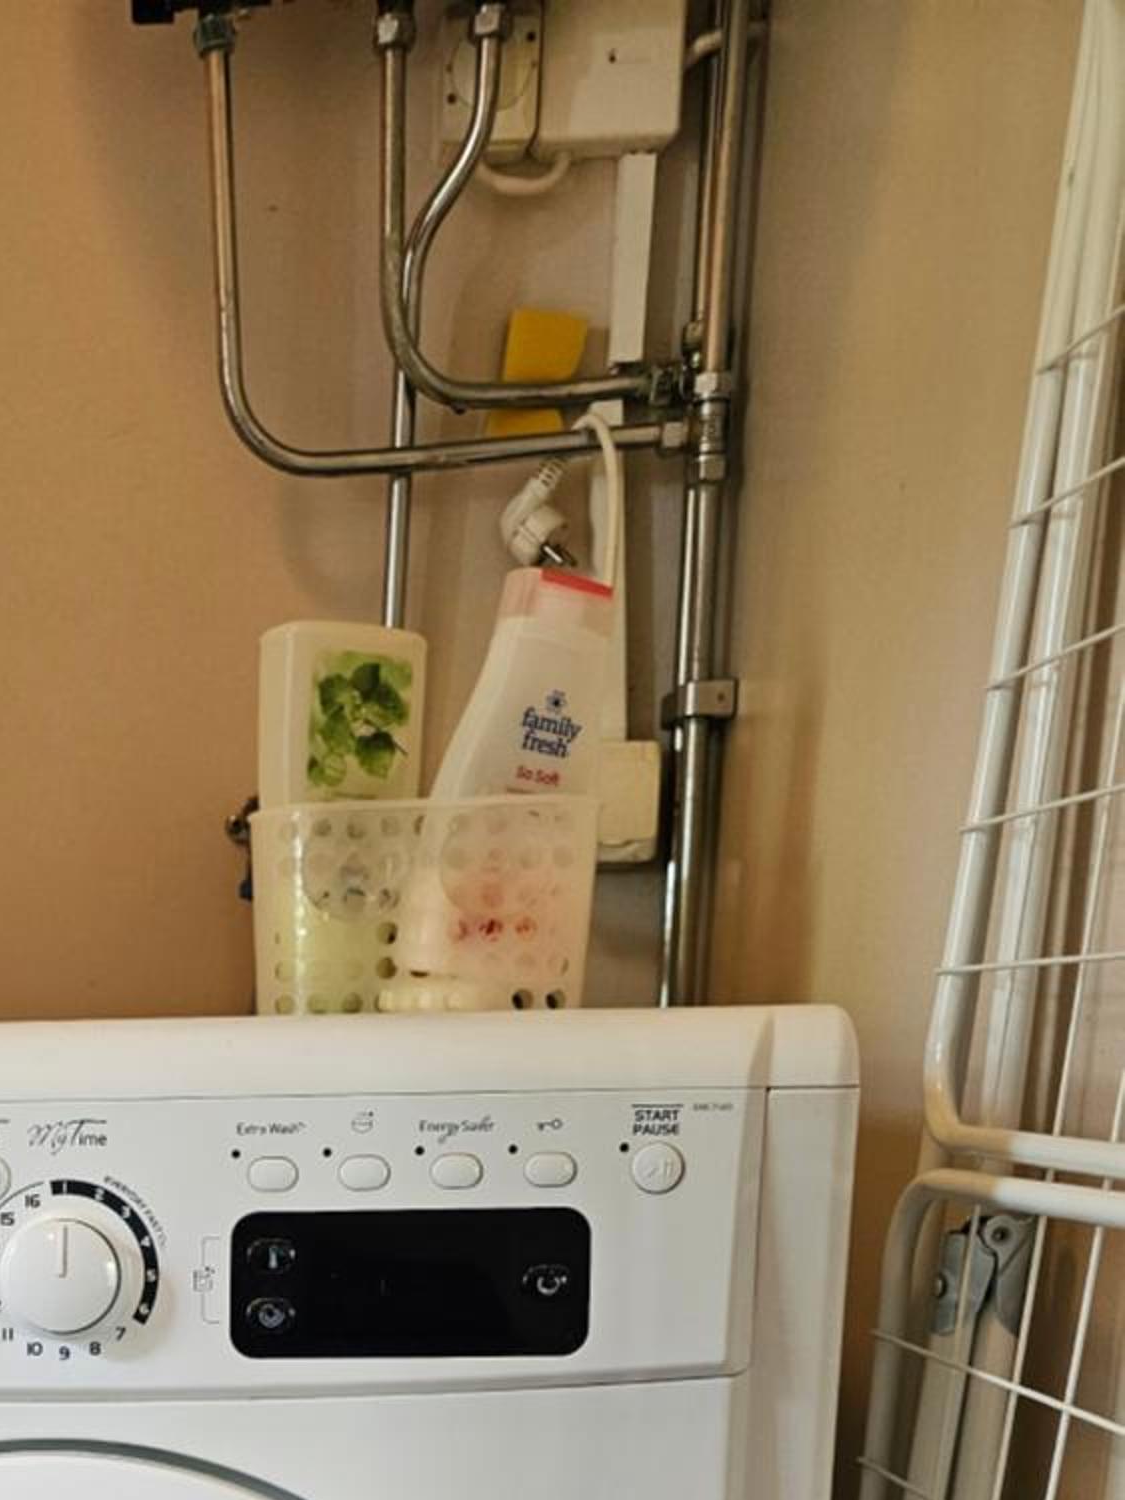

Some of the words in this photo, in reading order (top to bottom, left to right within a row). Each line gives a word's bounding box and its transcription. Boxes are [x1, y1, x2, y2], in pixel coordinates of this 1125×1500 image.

[521, 706, 582, 743] family
[522, 729, 567, 758] fresh
[634, 1109, 679, 1122] START
[633, 1123, 679, 1136] PAUSE
[24, 1193, 41, 1208] 16
[95, 1188, 105, 1201] 2
[0, 1212, 15, 1226] 15
[141, 1236, 151, 1248] 4
[139, 1302, 150, 1315] 6
[2, 1328, 14, 1341] 11
[115, 1327, 126, 1341] 7
[26, 1342, 44, 1356] 10
[59, 1346, 70, 1360] 9
[89, 1341, 102, 1356] 8
